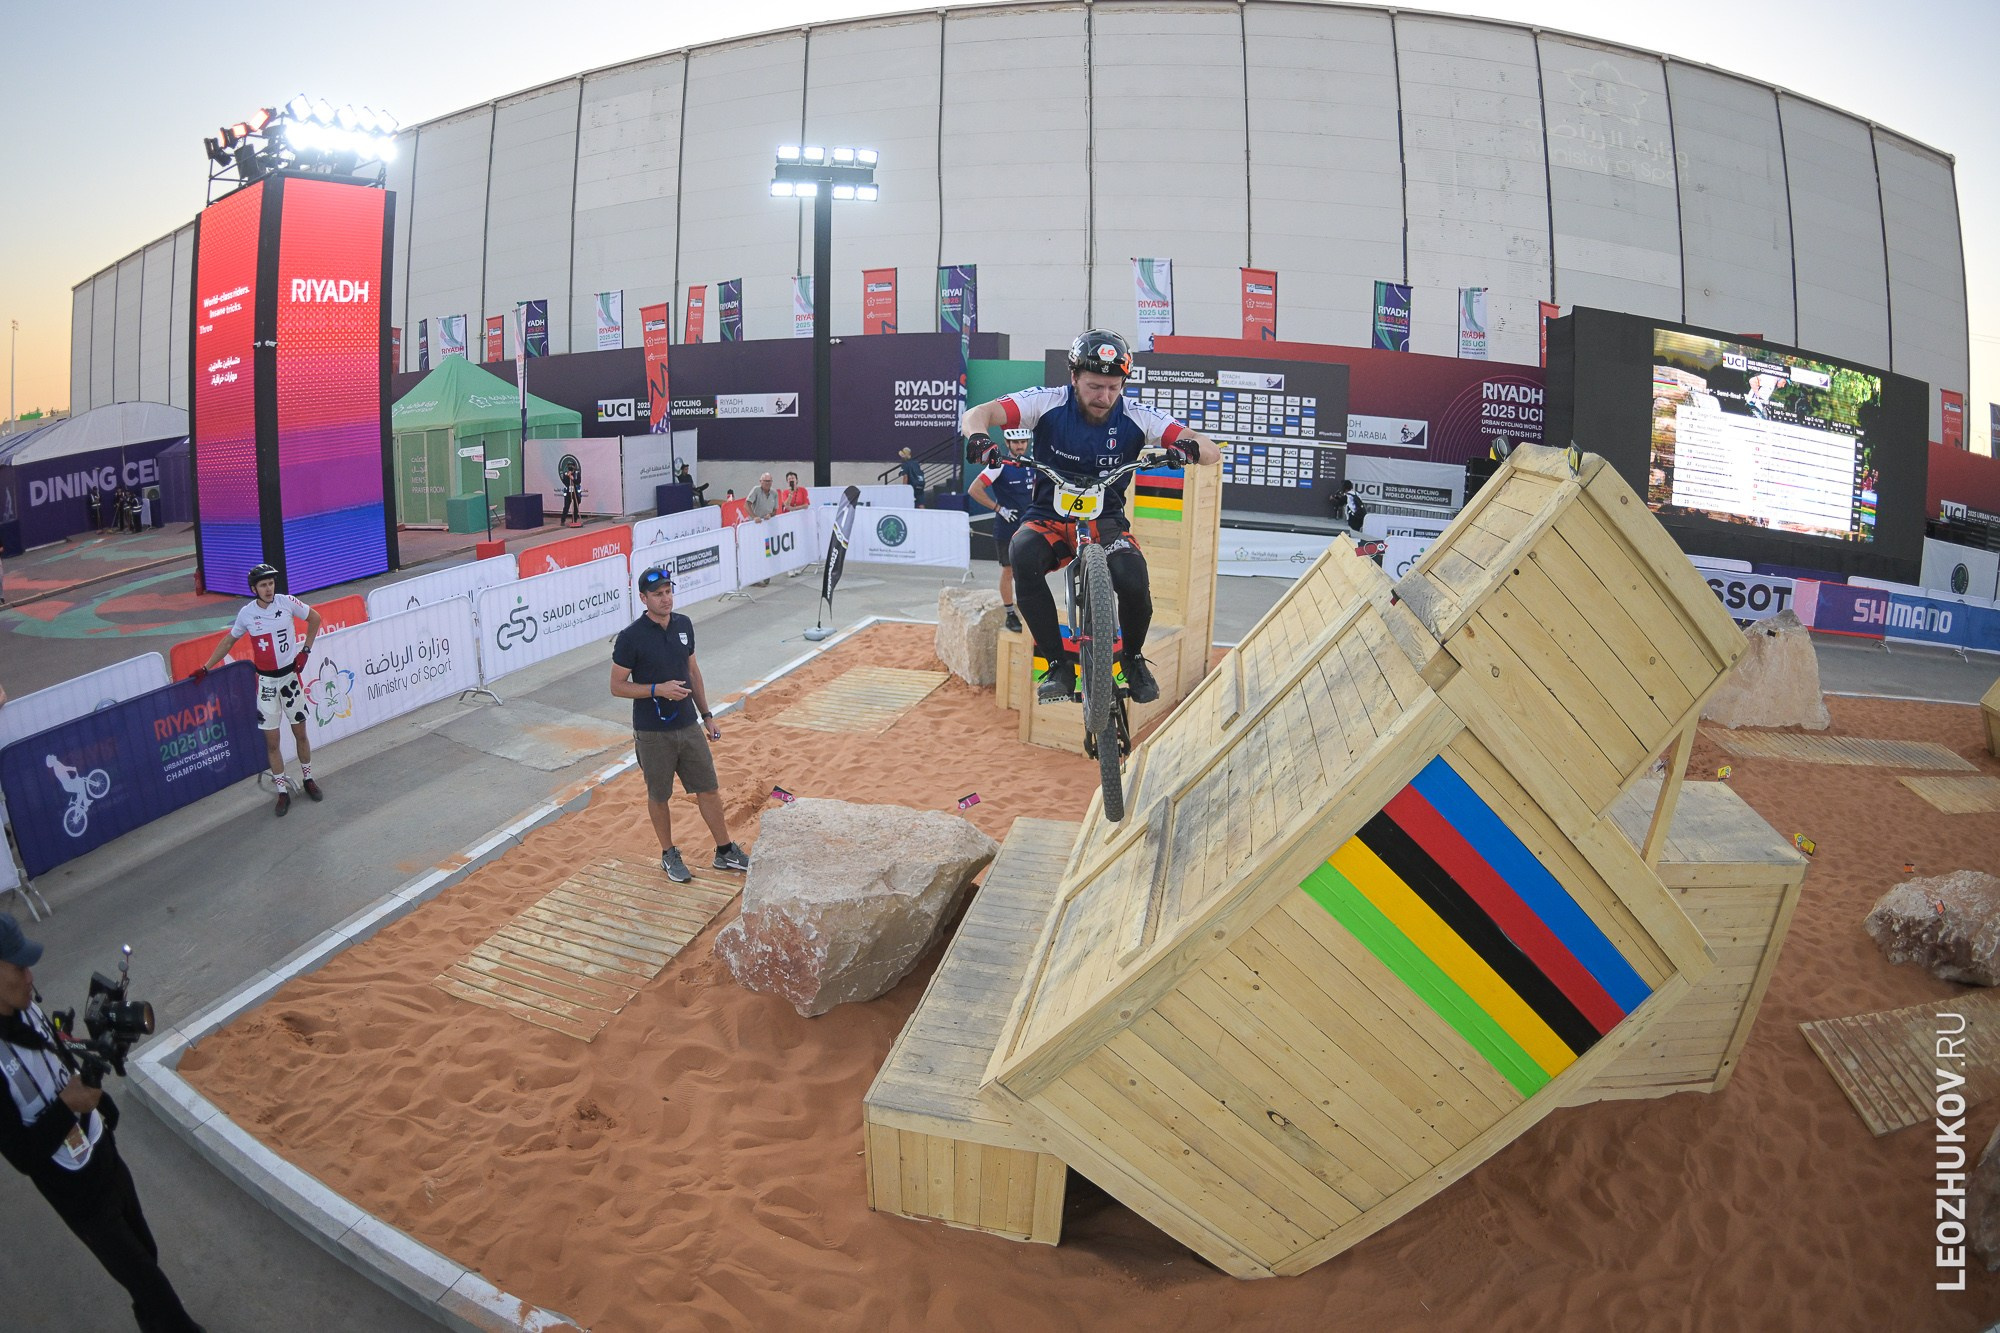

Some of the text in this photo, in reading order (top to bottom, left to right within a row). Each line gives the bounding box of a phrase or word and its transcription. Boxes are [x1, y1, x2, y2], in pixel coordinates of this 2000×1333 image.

[291, 279, 369, 303] RIYADH
[720, 300, 739, 310] RIYADH
[1138, 300, 1169, 308] RIYADH
[210, 306, 226, 318] Insane
[1378, 305, 1408, 318] RIYADH
[200, 325, 213, 334] Three
[599, 325, 621, 334] RIYADH
[441, 346, 464, 355] RIYADH
[1100, 348, 1115, 356] LG
[1727, 356, 1745, 368] UCI
[895, 380, 957, 396] RIYADH
[1169, 377, 1215, 385] CHAMPIONSHIPS
[1482, 382, 1543, 406] RIYADH
[604, 402, 632, 418] UCI
[674, 399, 702, 408] CYCLING
[895, 399, 957, 411] 2025 UCI
[1481, 403, 1543, 422] 2025 UCI
[1501, 421, 1523, 429] CYCLING
[1359, 431, 1387, 440] ARABIA
[1481, 427, 1542, 439] CHAMPIONSHIPS
[29, 466, 117, 507] DINING
[411, 486, 445, 494] PRAYER ROOM
[1354, 483, 1380, 496] UCI
[1074, 499, 1083, 510] 8
[1405, 494, 1449, 503] CHAMPIONSHIPS
[1945, 505, 1967, 520] UCI
[770, 532, 794, 555] UCI
[592, 543, 621, 559] RIYADH
[543, 589, 620, 623] SAUDI CYCLING
[1853, 599, 1953, 634] SHIMANO
[277, 628, 289, 653] SUI
[365, 638, 449, 675] وزارة الرياضة
[368, 660, 452, 700] Ministry of Sport
[154, 697, 222, 741] RIYADH
[160, 721, 227, 762] 2025 UCI
[163, 740, 229, 772] URBAN CYCLING WORLD
[166, 749, 231, 782] CHAMPIONSHIPS
[6, 1059, 19, 1076] 38
